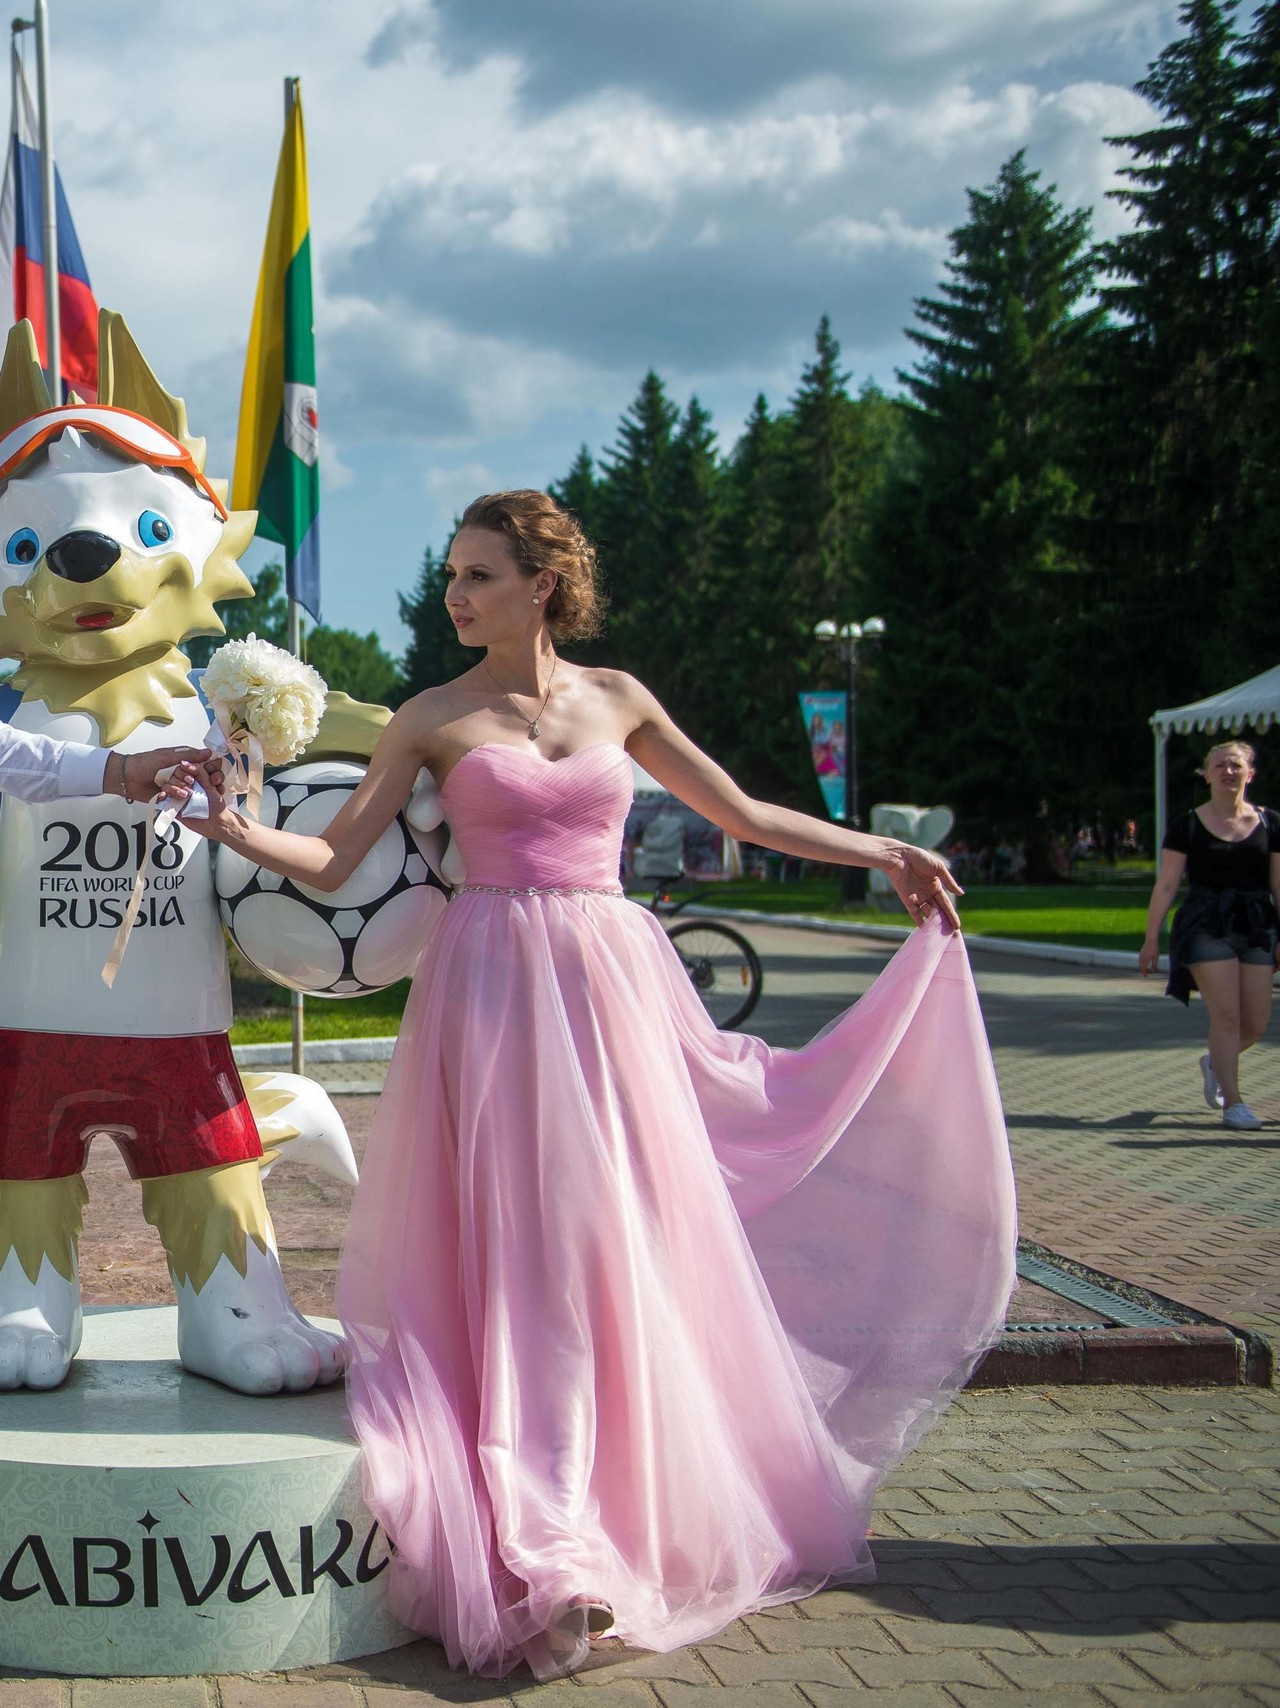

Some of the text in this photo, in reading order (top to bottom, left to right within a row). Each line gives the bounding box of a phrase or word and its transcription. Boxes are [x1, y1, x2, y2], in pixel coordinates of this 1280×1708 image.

[40, 820, 184, 872] 2018
[39, 877, 79, 892] FIFA
[153, 875, 185, 891] CUP
[39, 896, 186, 929] RUSSIA
